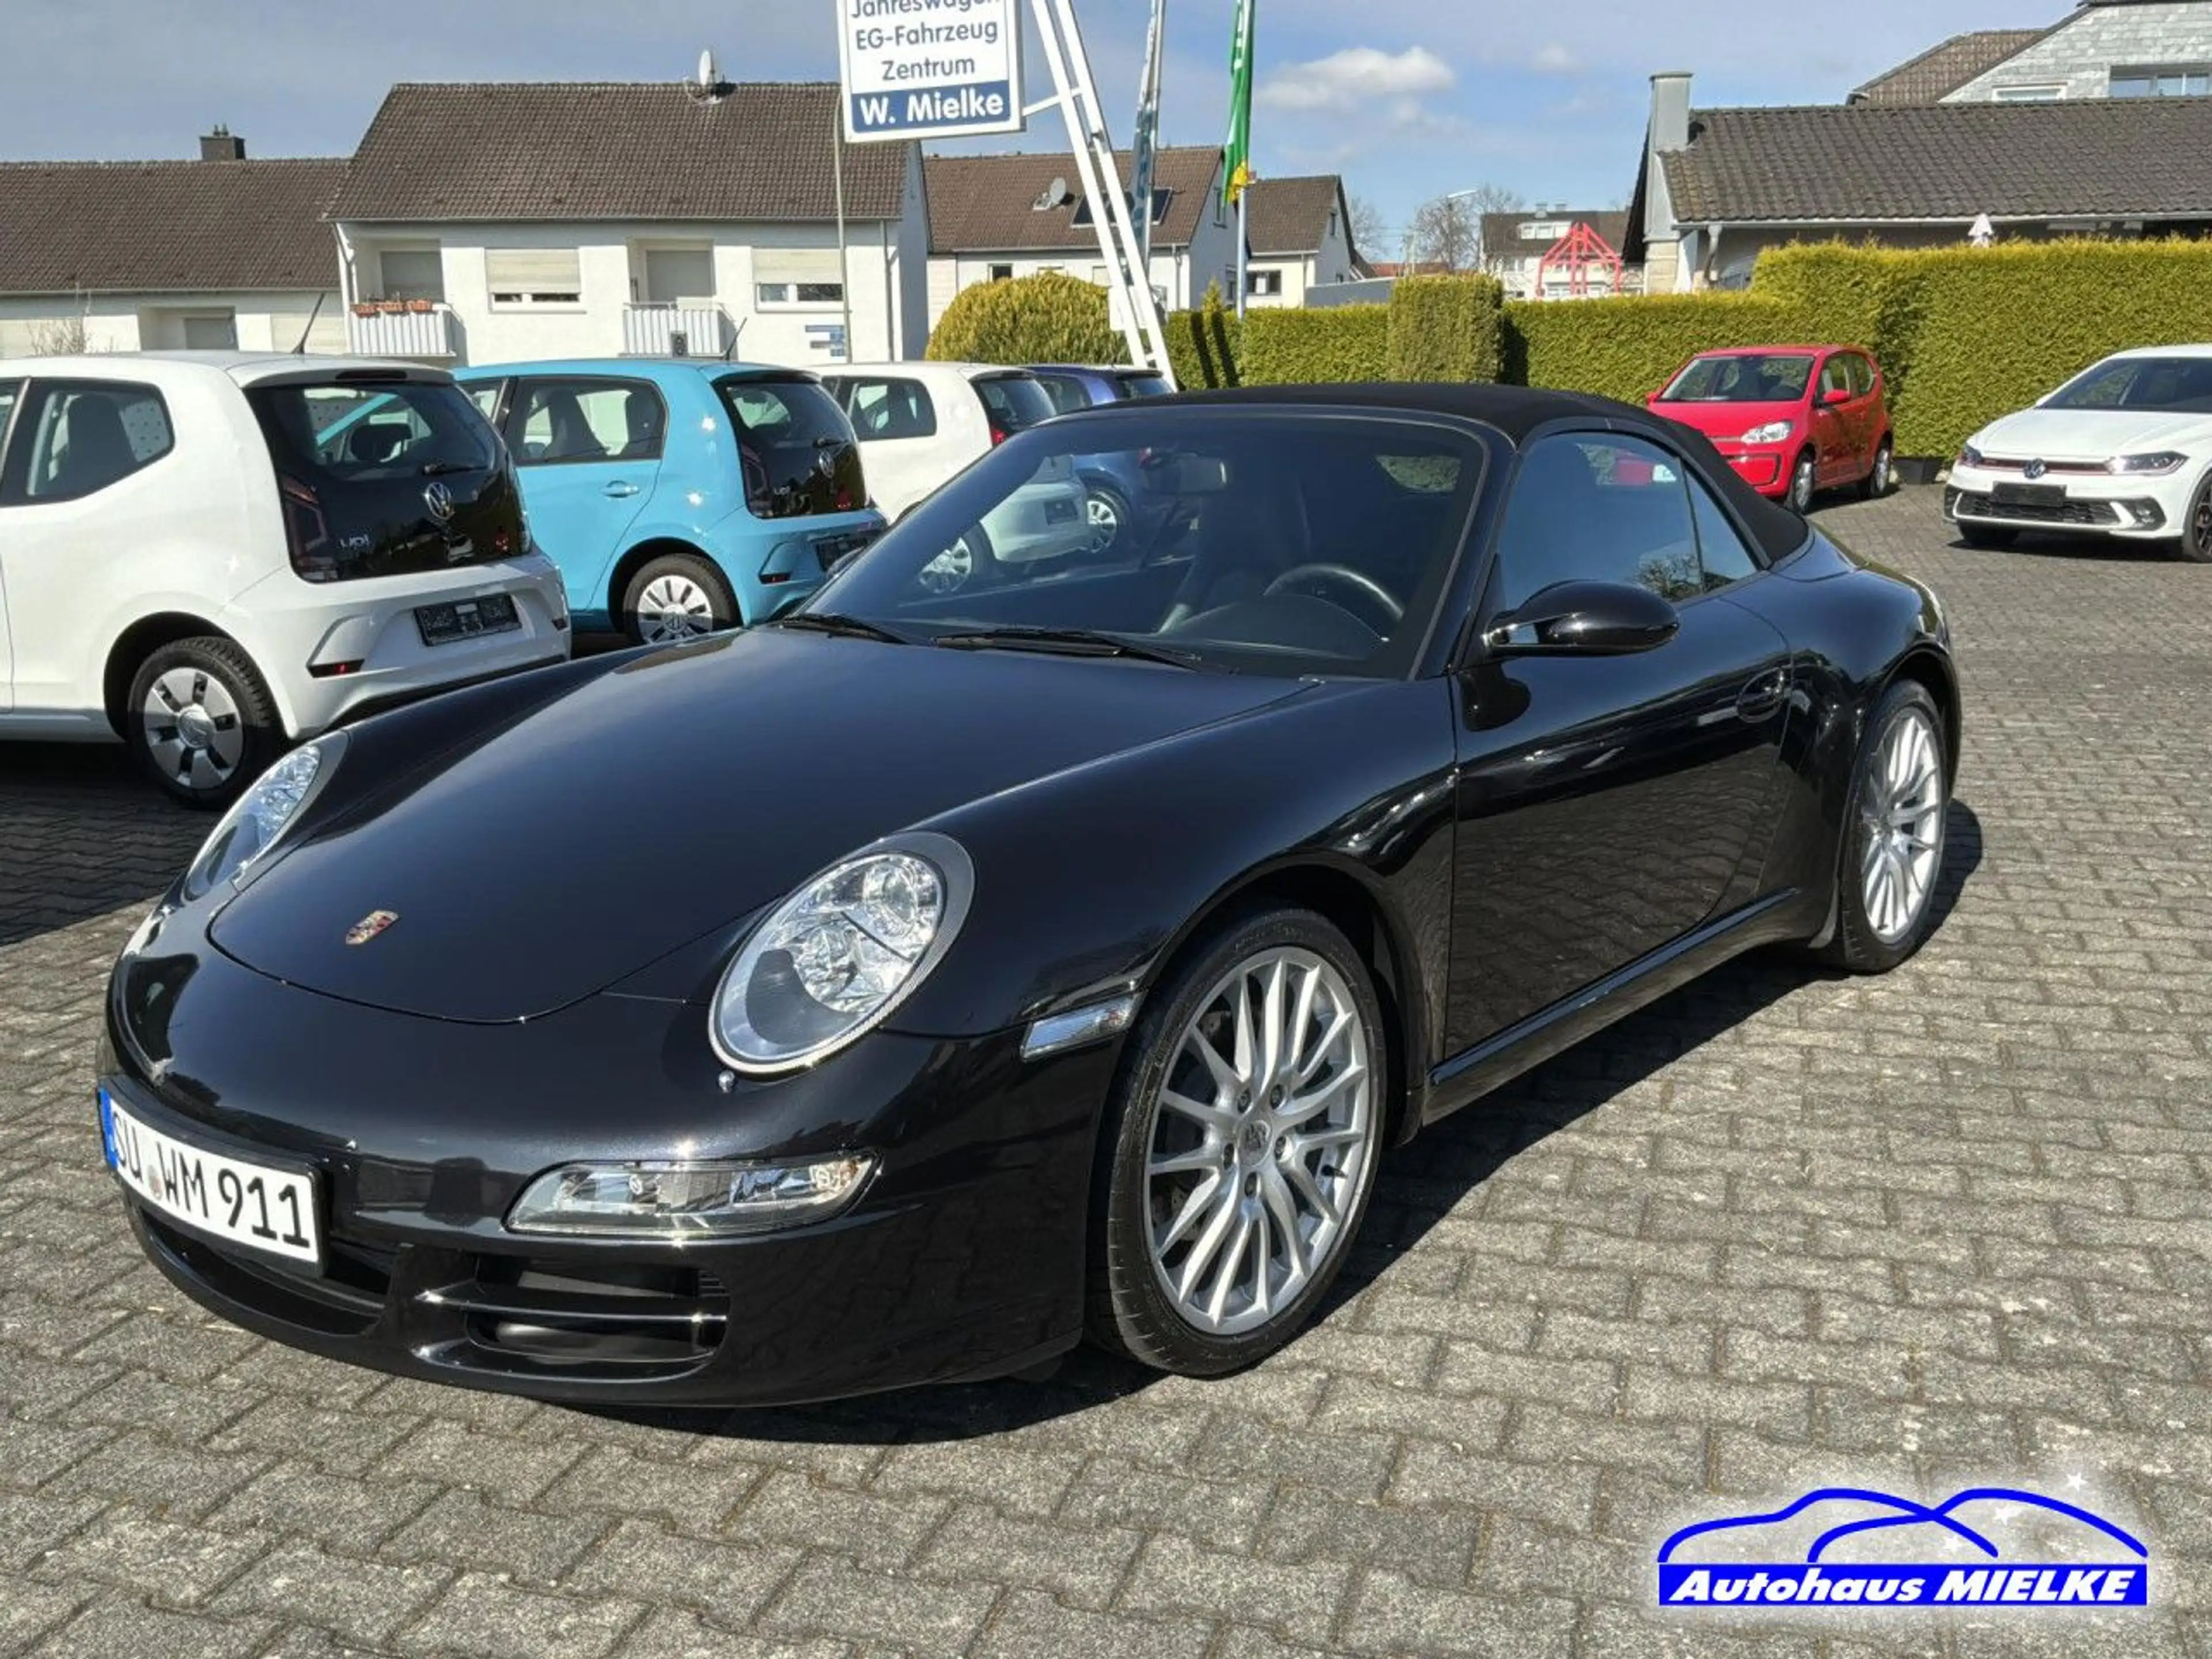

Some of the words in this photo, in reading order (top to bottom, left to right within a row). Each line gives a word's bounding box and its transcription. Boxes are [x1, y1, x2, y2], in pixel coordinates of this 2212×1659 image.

[856, 21, 997, 50] EG-Fahrzeug
[881, 58, 975, 81] Zentrum
[860, 96, 896, 125] W.
[907, 87, 1003, 122] Mielke
[156, 1141, 208, 1218] WM
[218, 1169, 310, 1248] 911
